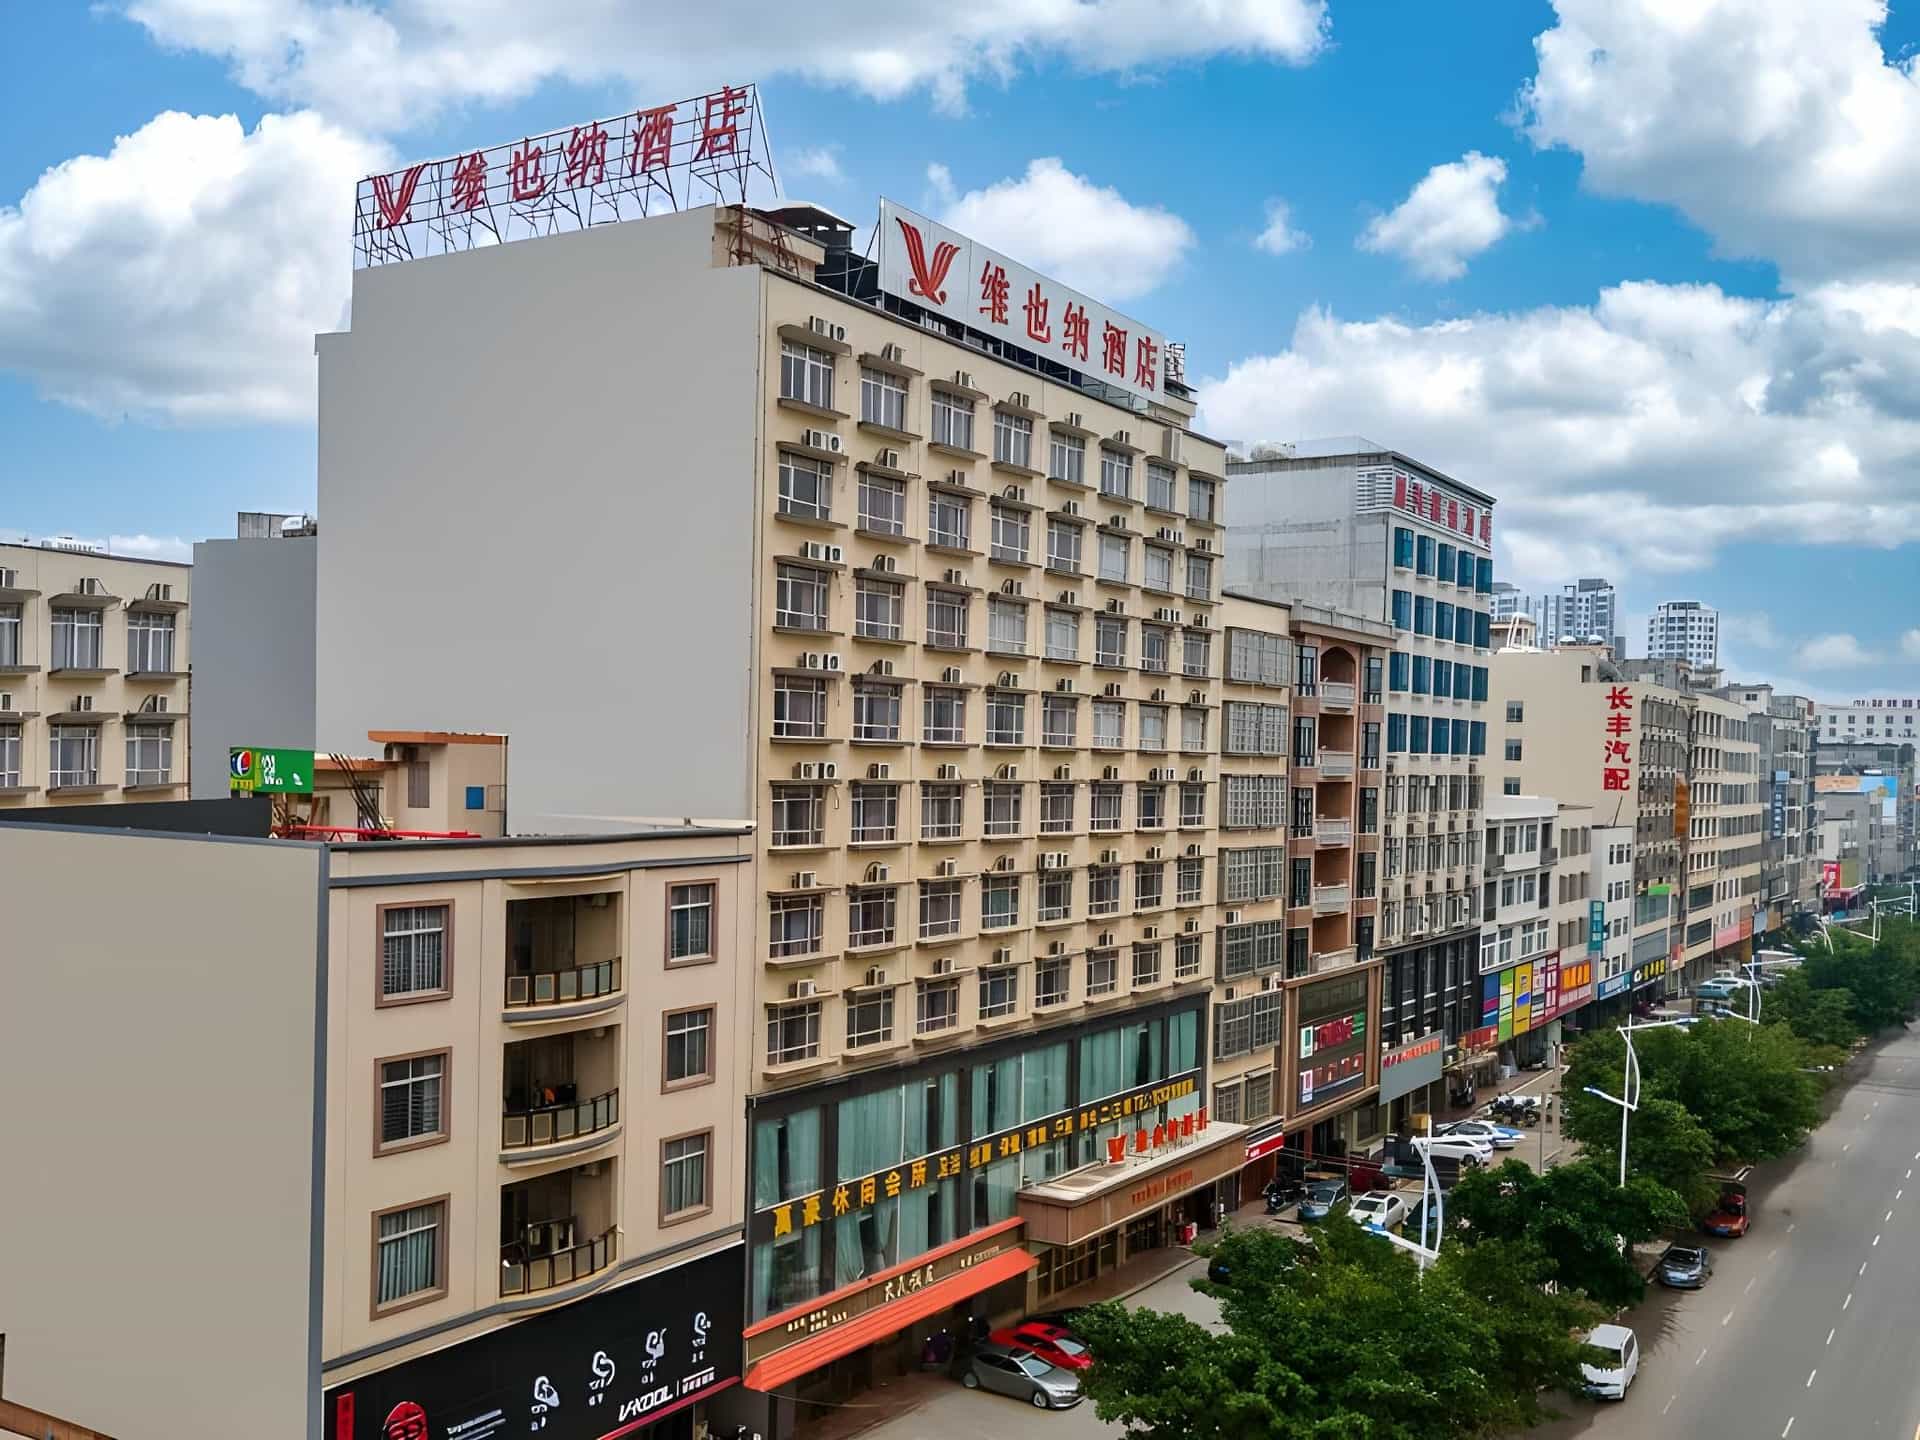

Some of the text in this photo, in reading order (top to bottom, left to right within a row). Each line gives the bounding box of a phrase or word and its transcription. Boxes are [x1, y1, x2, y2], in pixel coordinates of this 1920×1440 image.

[451, 86, 747, 211] 维也纳酒店
[978, 260, 1159, 392] 维也纳酒店
[1603, 686, 1633, 790] 长丰汽配
